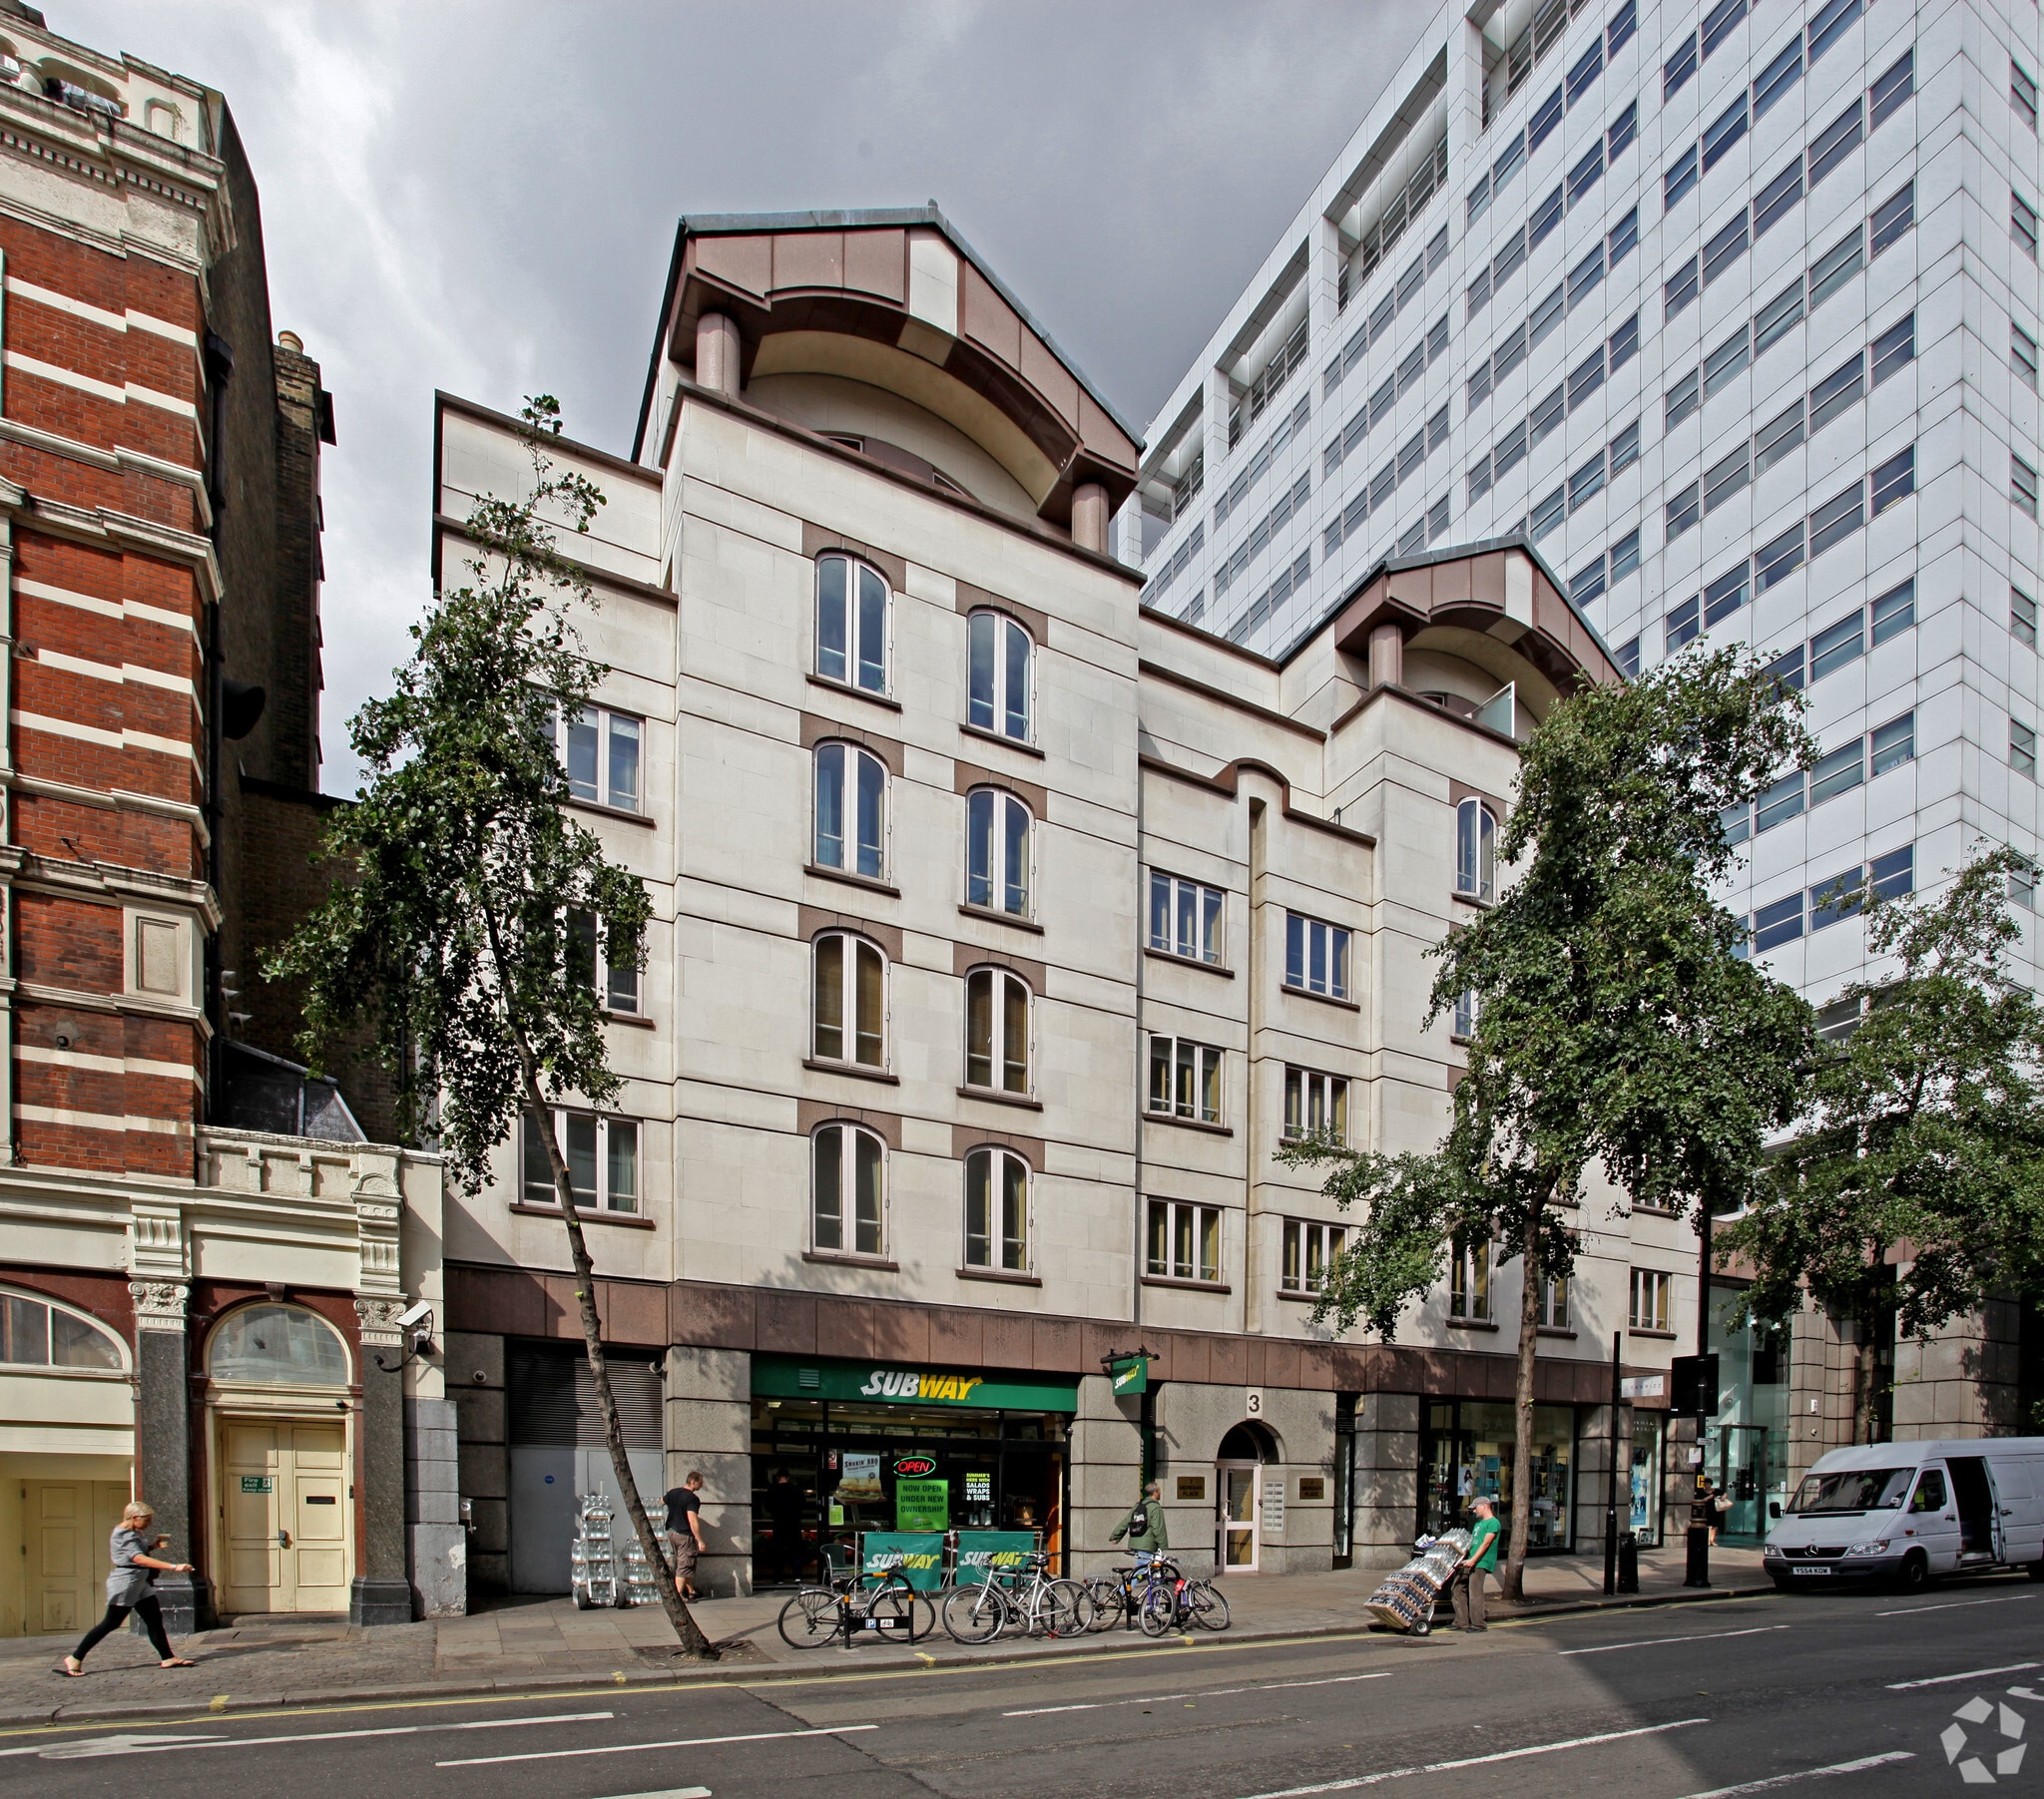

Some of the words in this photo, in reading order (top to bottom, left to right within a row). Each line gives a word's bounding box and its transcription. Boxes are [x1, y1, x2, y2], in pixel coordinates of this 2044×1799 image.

[860, 1370, 984, 1401] SUBWAY
[1115, 1365, 1140, 1389] SUBWAY
[1249, 1394, 1261, 1413] 3
[898, 1461, 930, 1473] OPEN
[900, 1505, 944, 1514] OWNERSHIP
